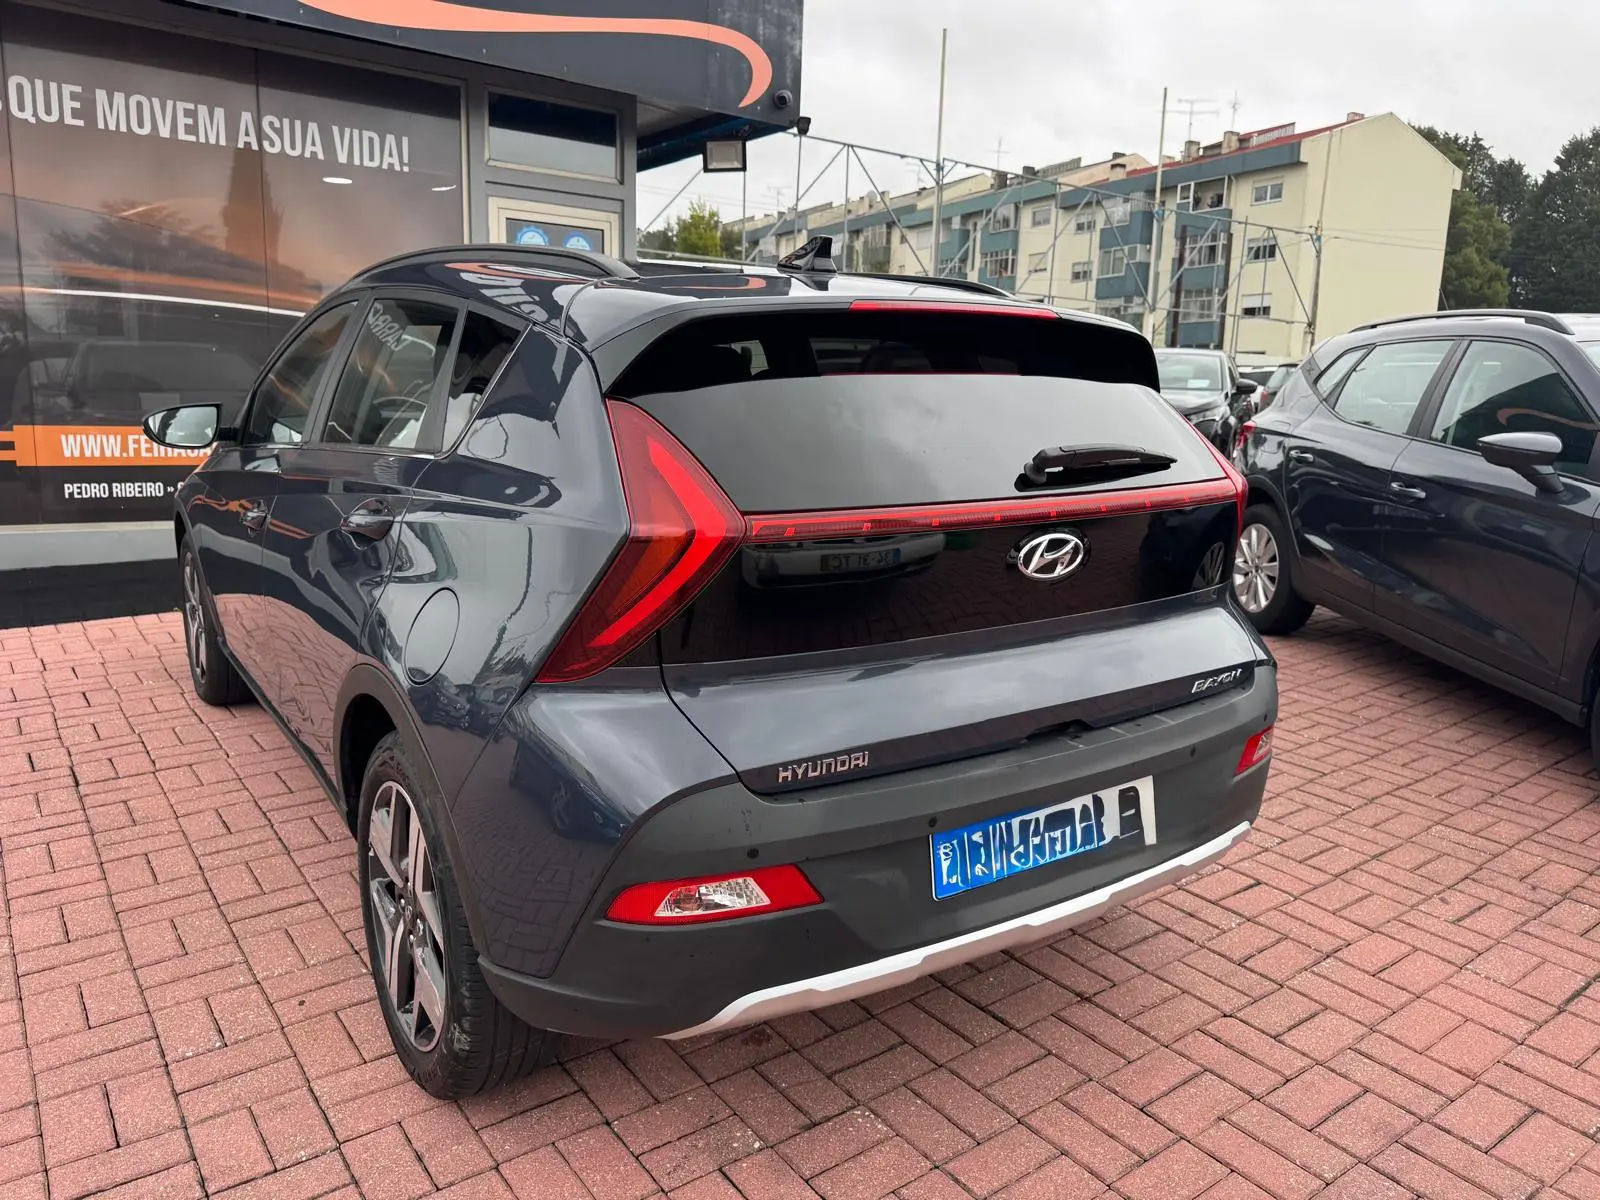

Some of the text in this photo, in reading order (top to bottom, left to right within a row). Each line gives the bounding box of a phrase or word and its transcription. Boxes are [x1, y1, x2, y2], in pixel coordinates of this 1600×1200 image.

[8, 75, 84, 126] QUE
[95, 88, 226, 146] MOVEM
[332, 125, 409, 173] VIDA!
[64, 482, 109, 498] PEDRO
[113, 482, 164, 497] RIBEIRO
[778, 751, 868, 783] HYUNDAI
